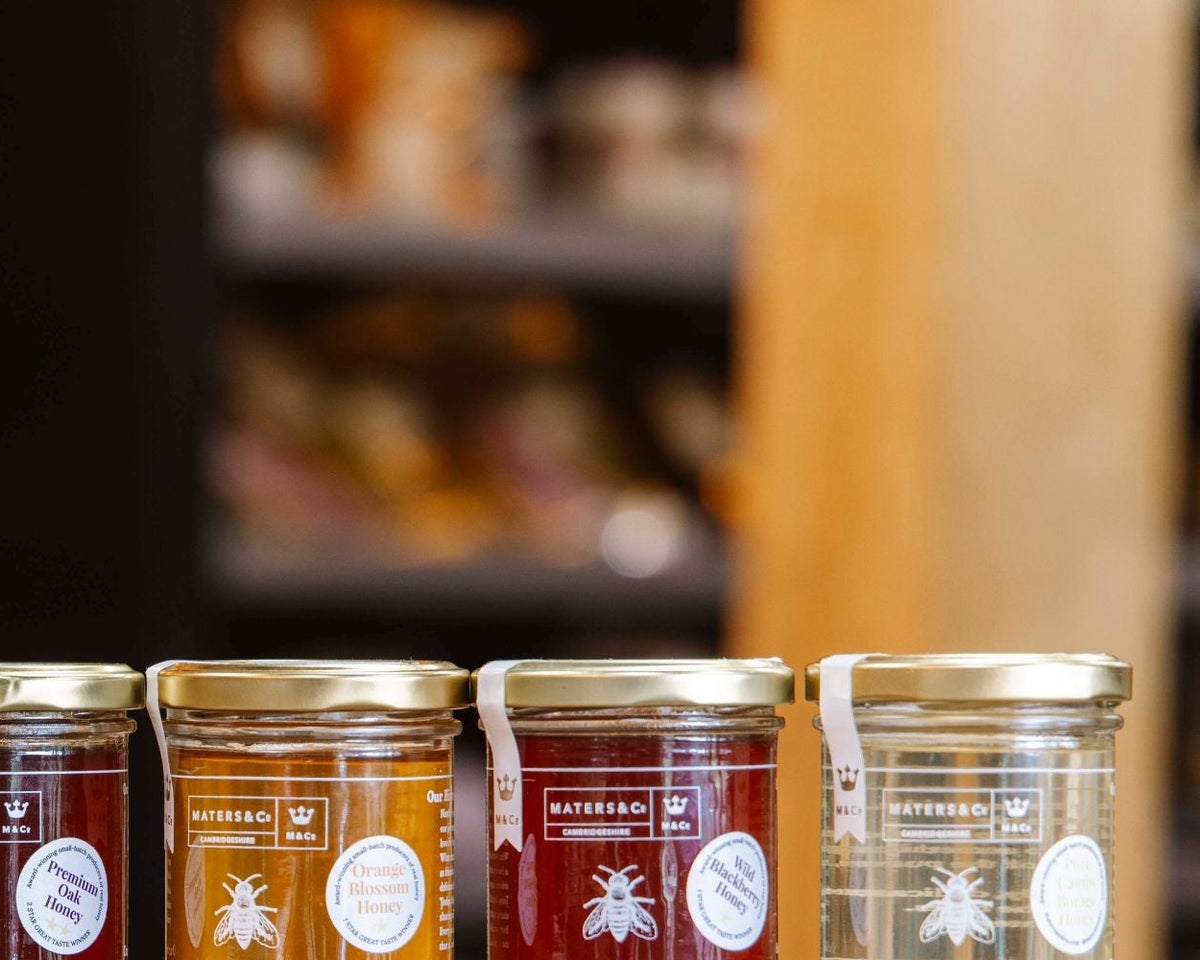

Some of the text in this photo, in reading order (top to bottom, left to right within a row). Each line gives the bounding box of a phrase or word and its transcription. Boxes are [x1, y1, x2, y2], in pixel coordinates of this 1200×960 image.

[426, 789, 443, 804] Our
[562, 827, 631, 836] CAMBRIDGESHIRE
[47, 859, 99, 897] Premium
[352, 863, 406, 879] Orange
[734, 855, 756, 882] Wild
[58, 883, 82, 906] Oak
[349, 881, 409, 896] Blossom
[709, 858, 761, 910] Blackberry
[44, 895, 83, 925] Honey
[357, 900, 404, 916] Honey
[715, 881, 748, 916] Honey
[27, 908, 37, 925] STAR
[34, 924, 53, 942] GREAT
[52, 939, 70, 948] TASTE
[70, 930, 91, 946] WINNER
[345, 920, 360, 937] STAR
[359, 934, 380, 945] GREAT
[380, 935, 399, 946] TASTE
[397, 913, 414, 938] WINNER
